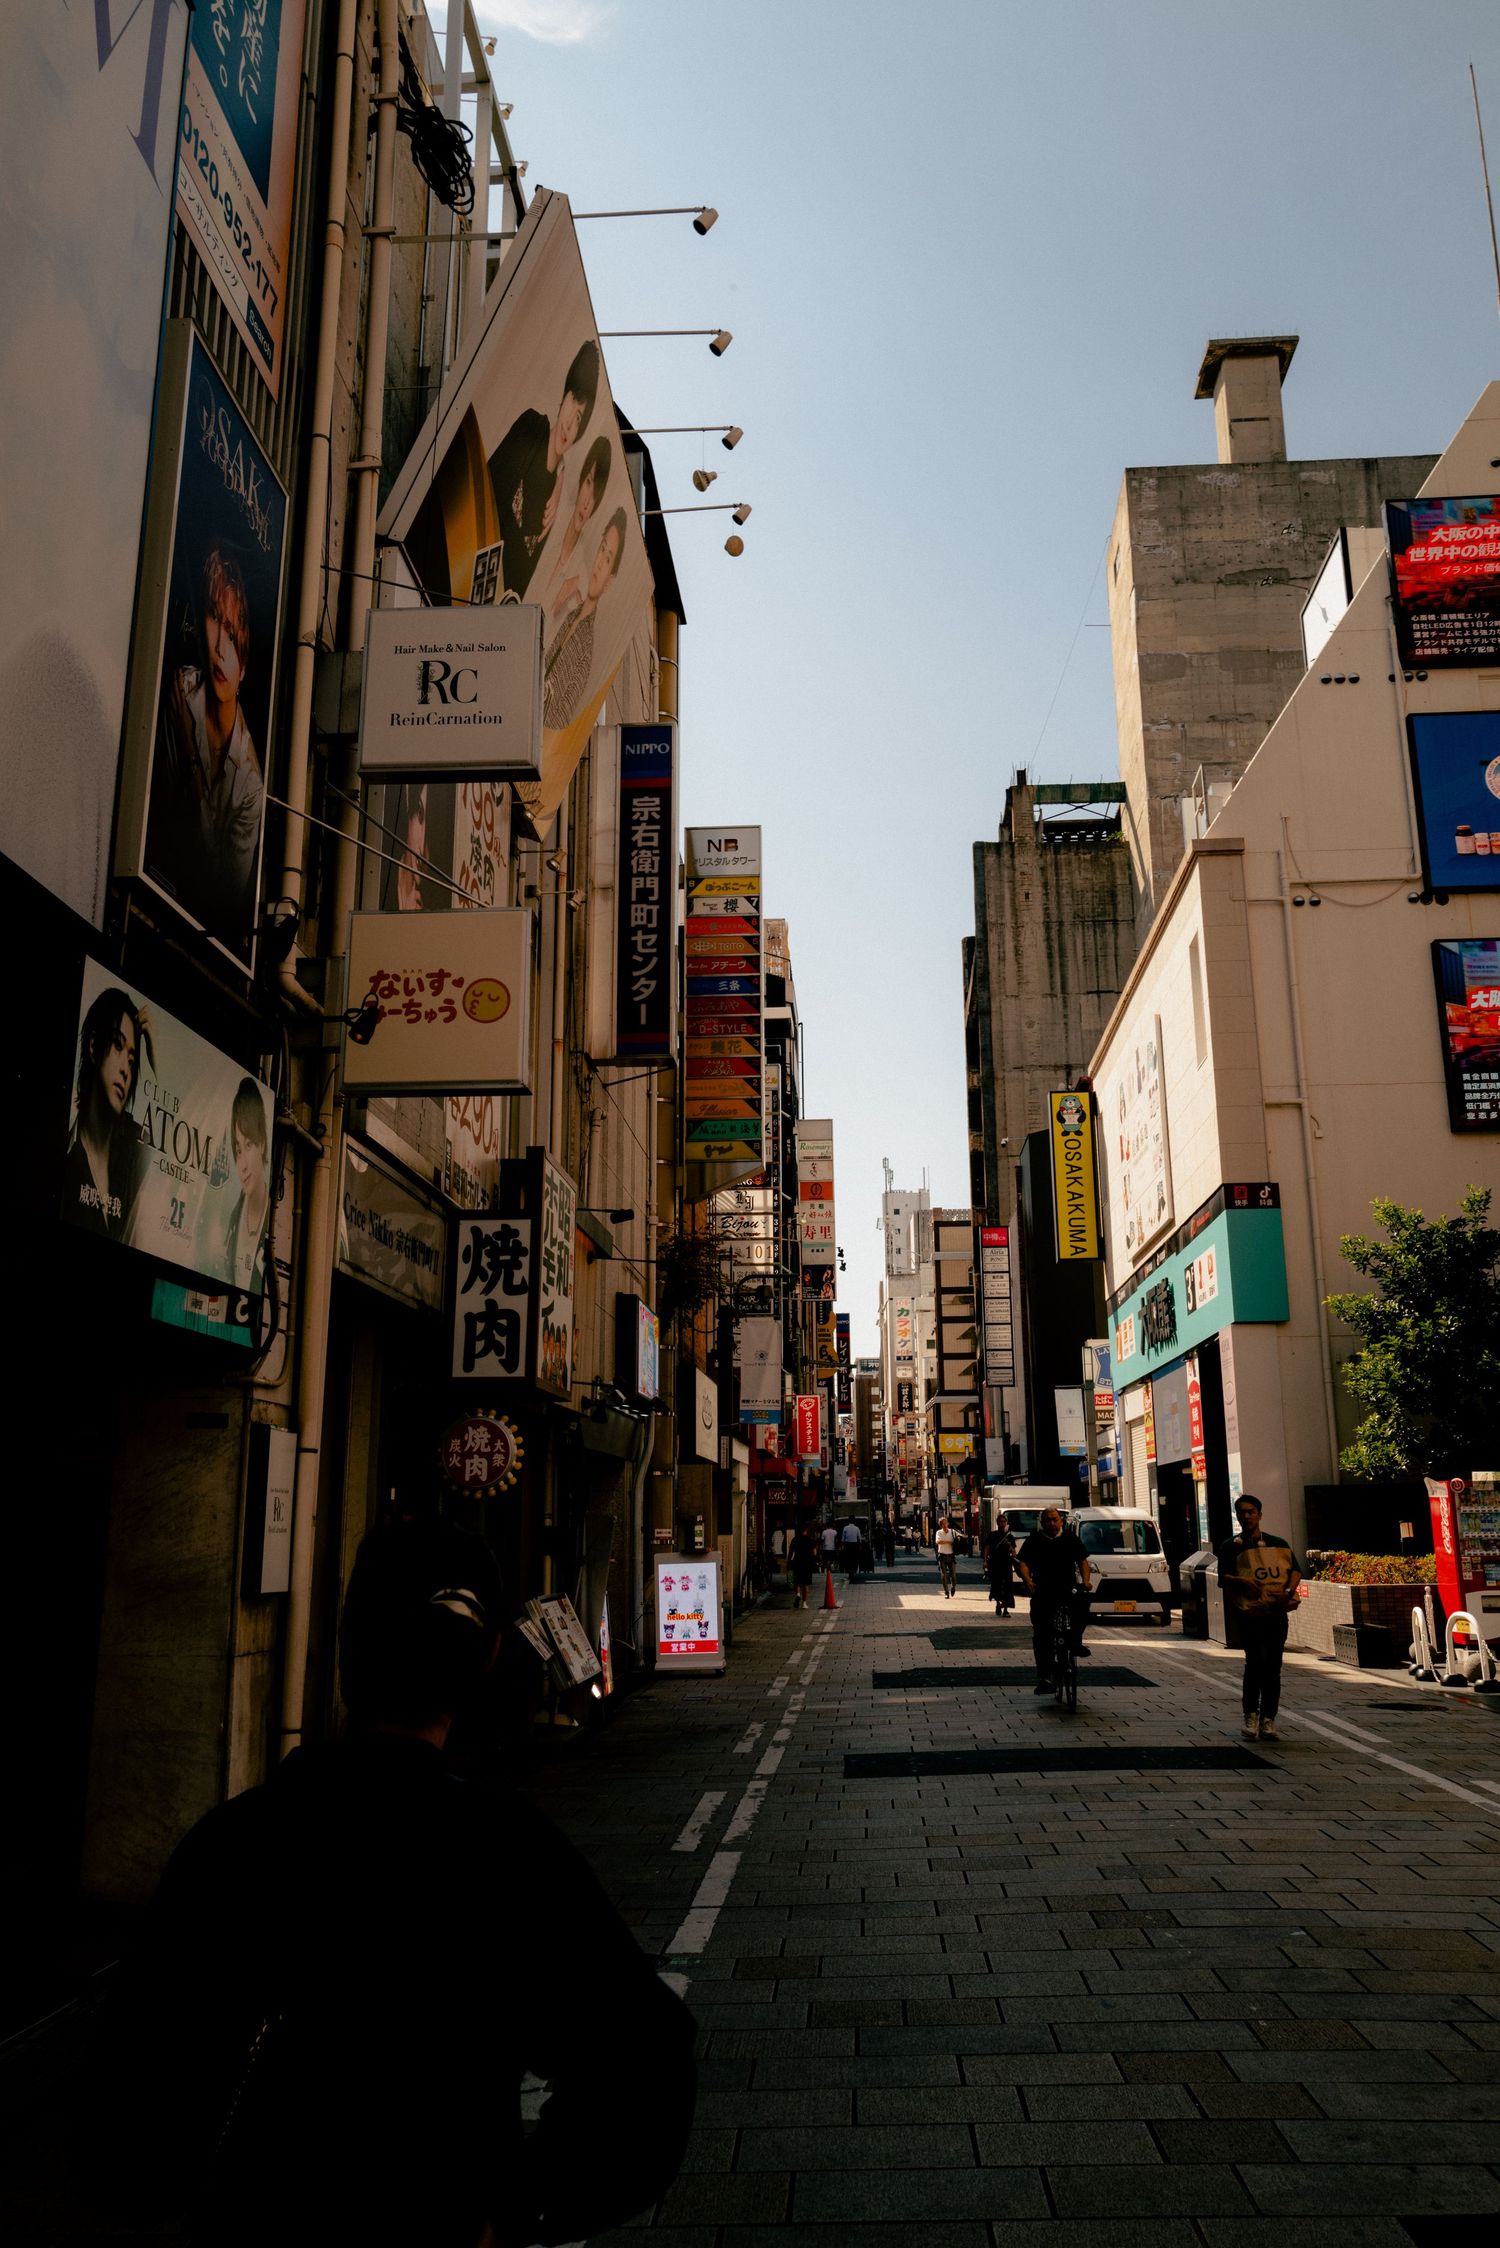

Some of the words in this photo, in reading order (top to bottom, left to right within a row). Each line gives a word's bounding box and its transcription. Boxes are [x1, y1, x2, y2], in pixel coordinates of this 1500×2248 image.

[250, 310, 273, 361] Search
[1409, 542, 1500, 562] 世界中の観
[394, 645, 416, 654] Hair
[419, 644, 444, 653] Make
[446, 644, 453, 653] &
[455, 643, 474, 652] Nail
[477, 642, 506, 651] Salon
[418, 660, 478, 705] RC
[390, 710, 502, 726] ReinCarnation
[625, 743, 670, 756] NIPPO
[630, 795, 662, 1026] 宗右衛門町センター
[750, 897, 759, 907] 7
[143, 1079, 179, 1114] CLUB
[137, 1101, 212, 1177] ATOM
[170, 1197, 185, 1230] 2F
[1064, 1138, 1087, 1257] OSAKAKUMA
[368, 1210, 393, 1249] Nikko
[557, 1178, 573, 1298] 昭和
[721, 1216, 760, 1232] Bijou
[460, 1223, 529, 1375] 焼肉
[897, 1307, 911, 1348] カラオケ
[448, 1439, 461, 1468] 炭火
[463, 1425, 491, 1482] 焼肉
[1254, 1566, 1280, 1580] GU
[667, 1613, 686, 1621] hello
[686, 1613, 704, 1623] kitty
[670, 1642, 696, 1653] 営業中
